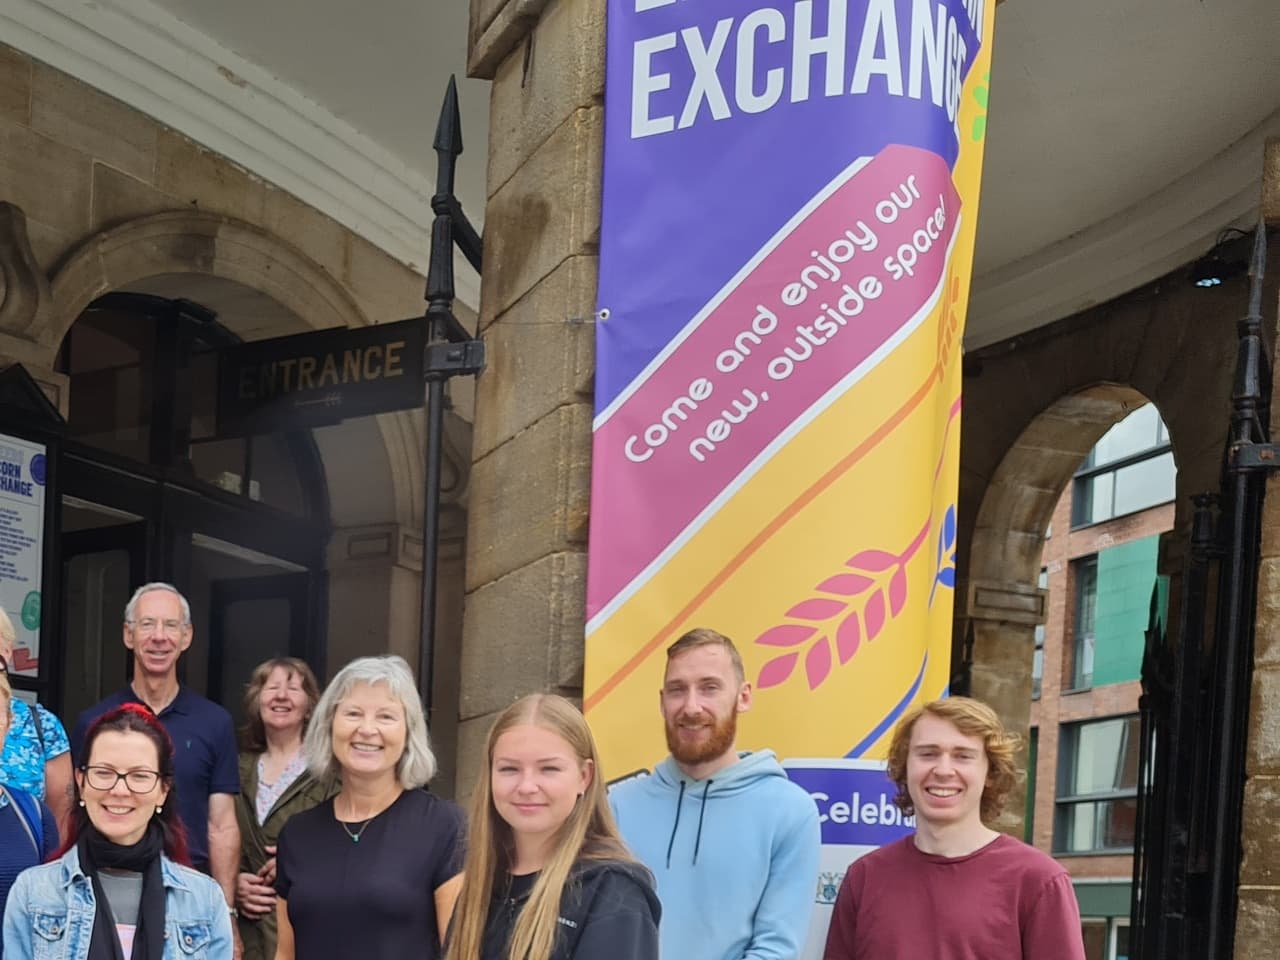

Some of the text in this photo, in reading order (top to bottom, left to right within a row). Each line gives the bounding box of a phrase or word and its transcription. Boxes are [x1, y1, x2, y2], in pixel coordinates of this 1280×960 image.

[238, 341, 407, 400] ENTRANCE
[624, 175, 919, 463] Come and enjoy our
[688, 195, 947, 462] new, outside space!
